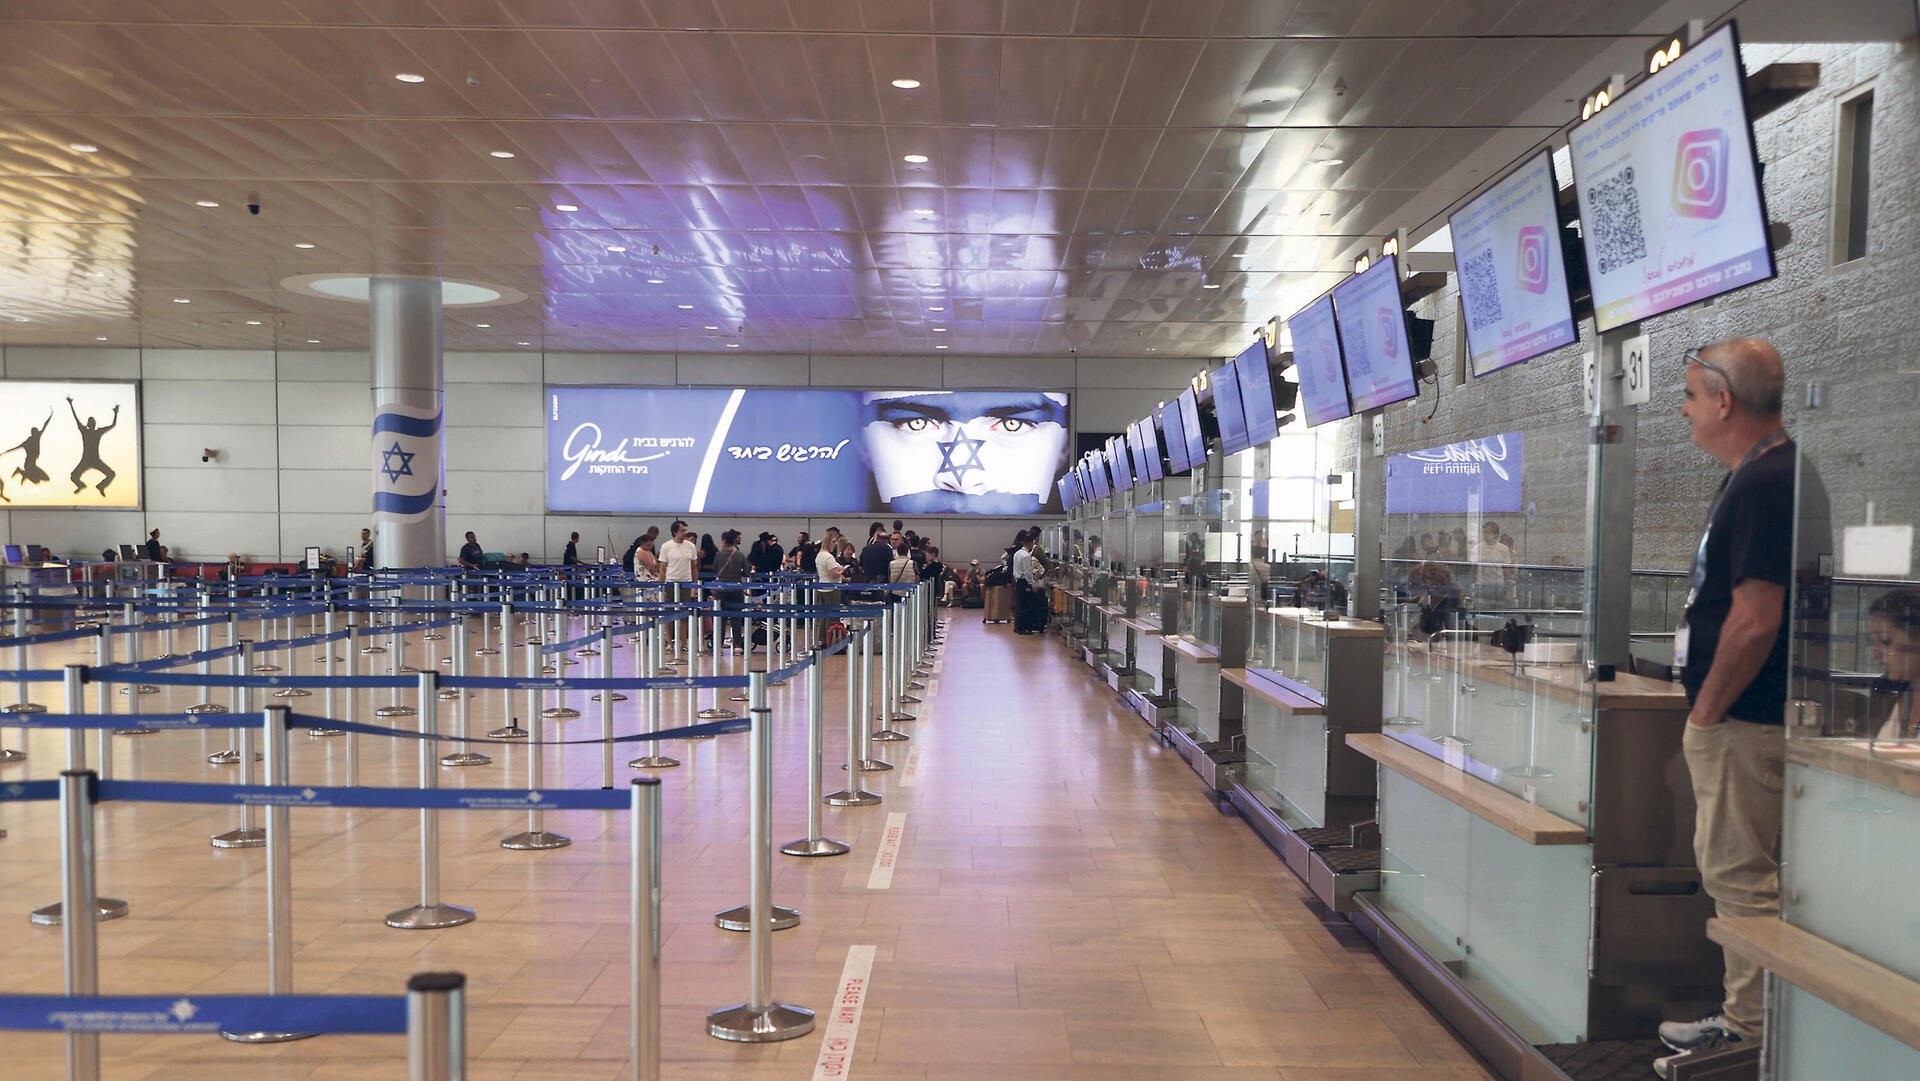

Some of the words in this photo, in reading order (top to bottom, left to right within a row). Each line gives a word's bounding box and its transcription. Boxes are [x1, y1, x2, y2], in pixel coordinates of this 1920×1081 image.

[1630, 350, 1643, 391] 31
[633, 437, 658, 448] בבית
[660, 436, 695, 448] להרגיש
[776, 438, 850, 462] להרגיש
[561, 422, 670, 481] Gindi
[728, 446, 772, 460] ביחד
[589, 465, 625, 476] החזקות
[628, 465, 648, 474] גינדי
[842, 978, 864, 1004] PLEASE
[837, 1006, 857, 1024] WAIT
